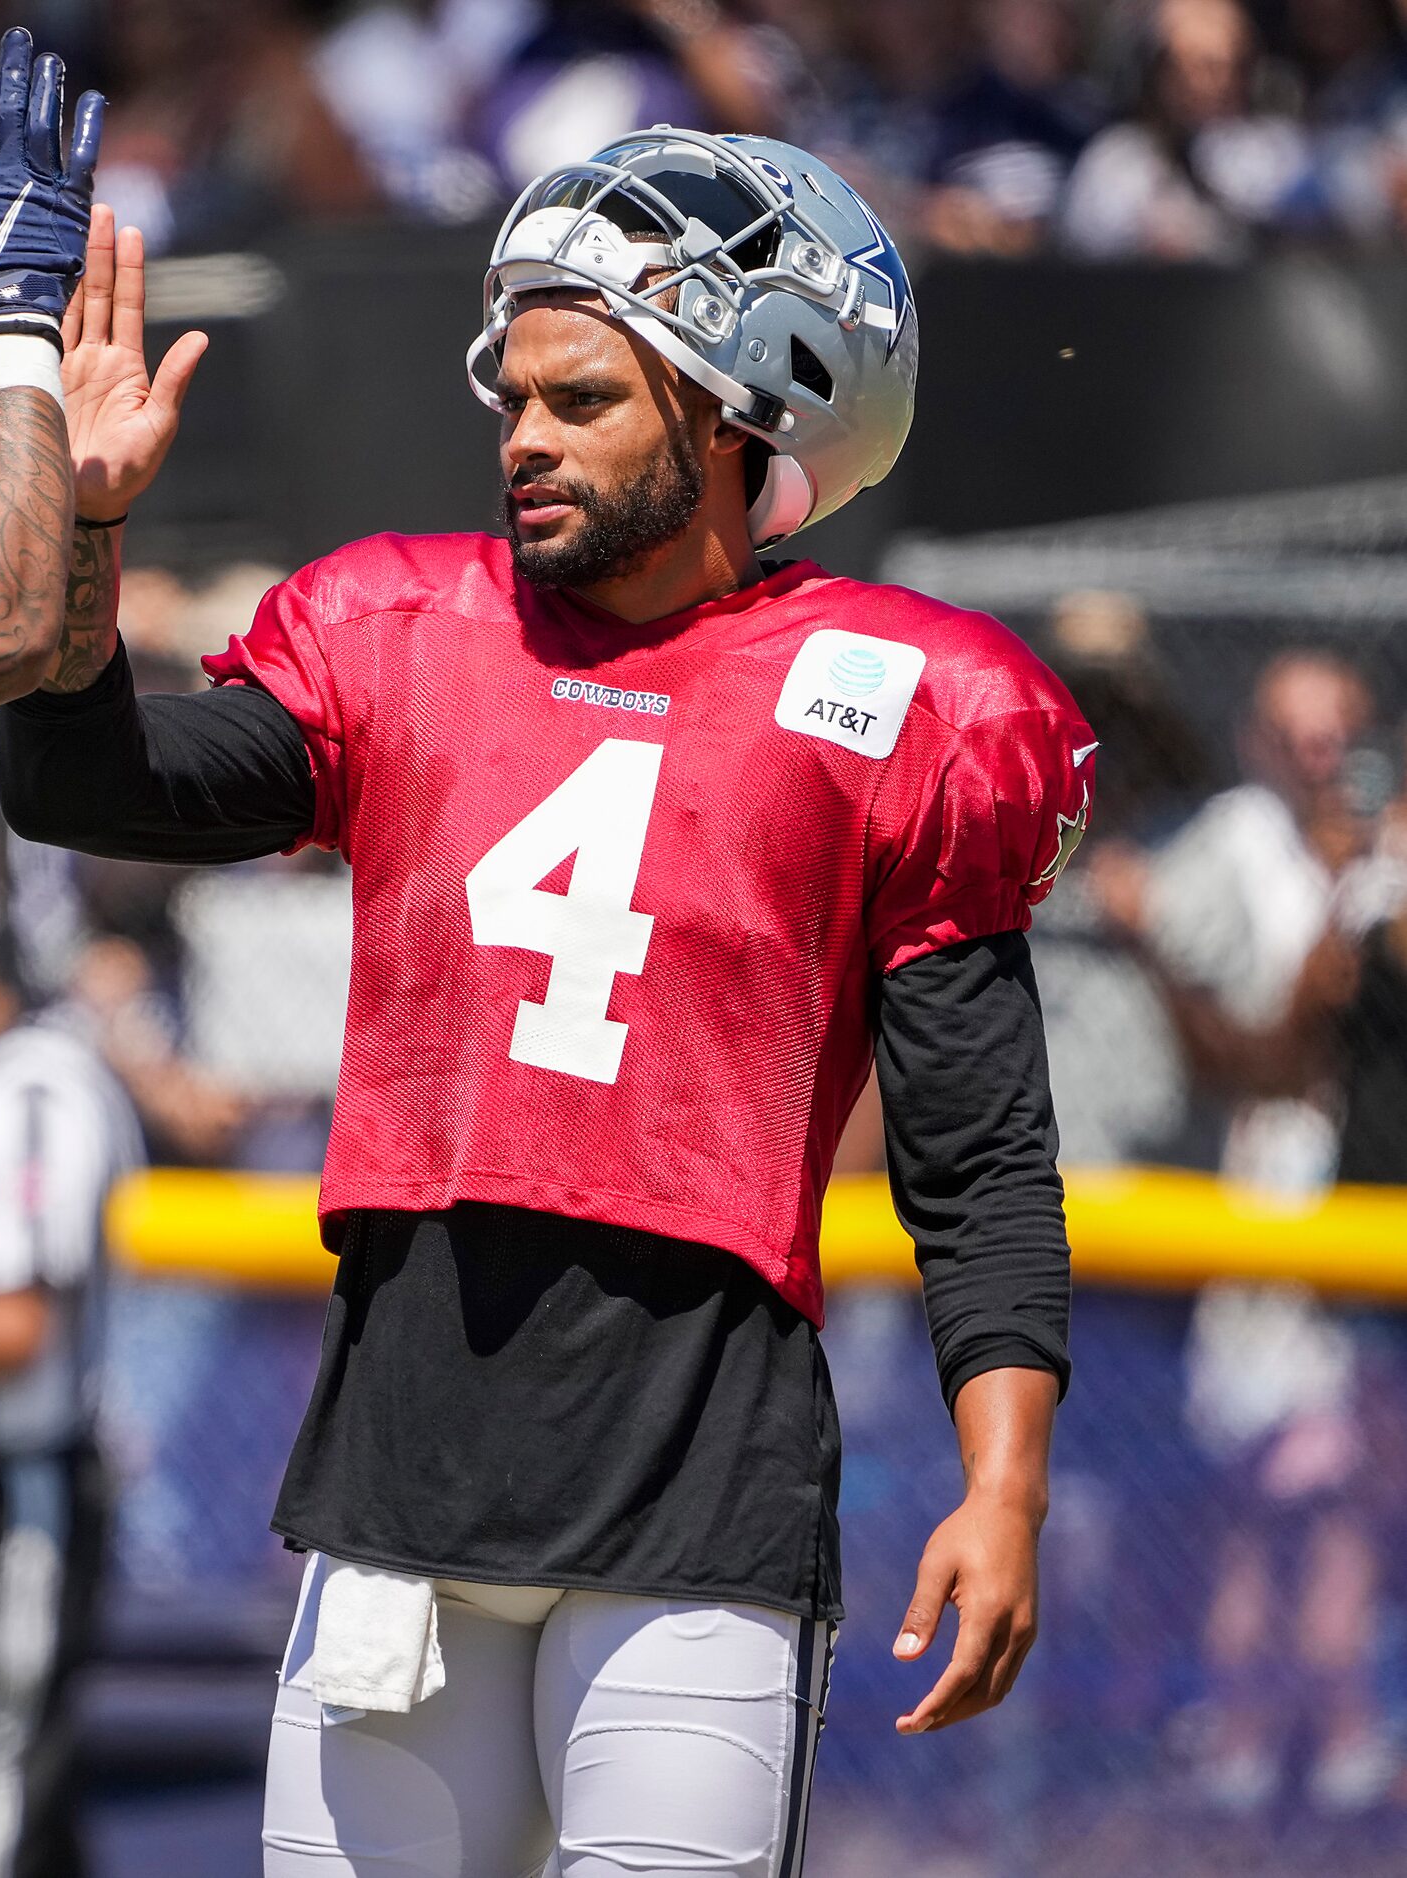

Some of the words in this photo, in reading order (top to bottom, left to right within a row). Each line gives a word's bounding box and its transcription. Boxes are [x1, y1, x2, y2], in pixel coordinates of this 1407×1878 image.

[552, 679, 670, 714] COWBOYS
[804, 697, 878, 736] AT&T
[465, 737, 665, 1085] 4
